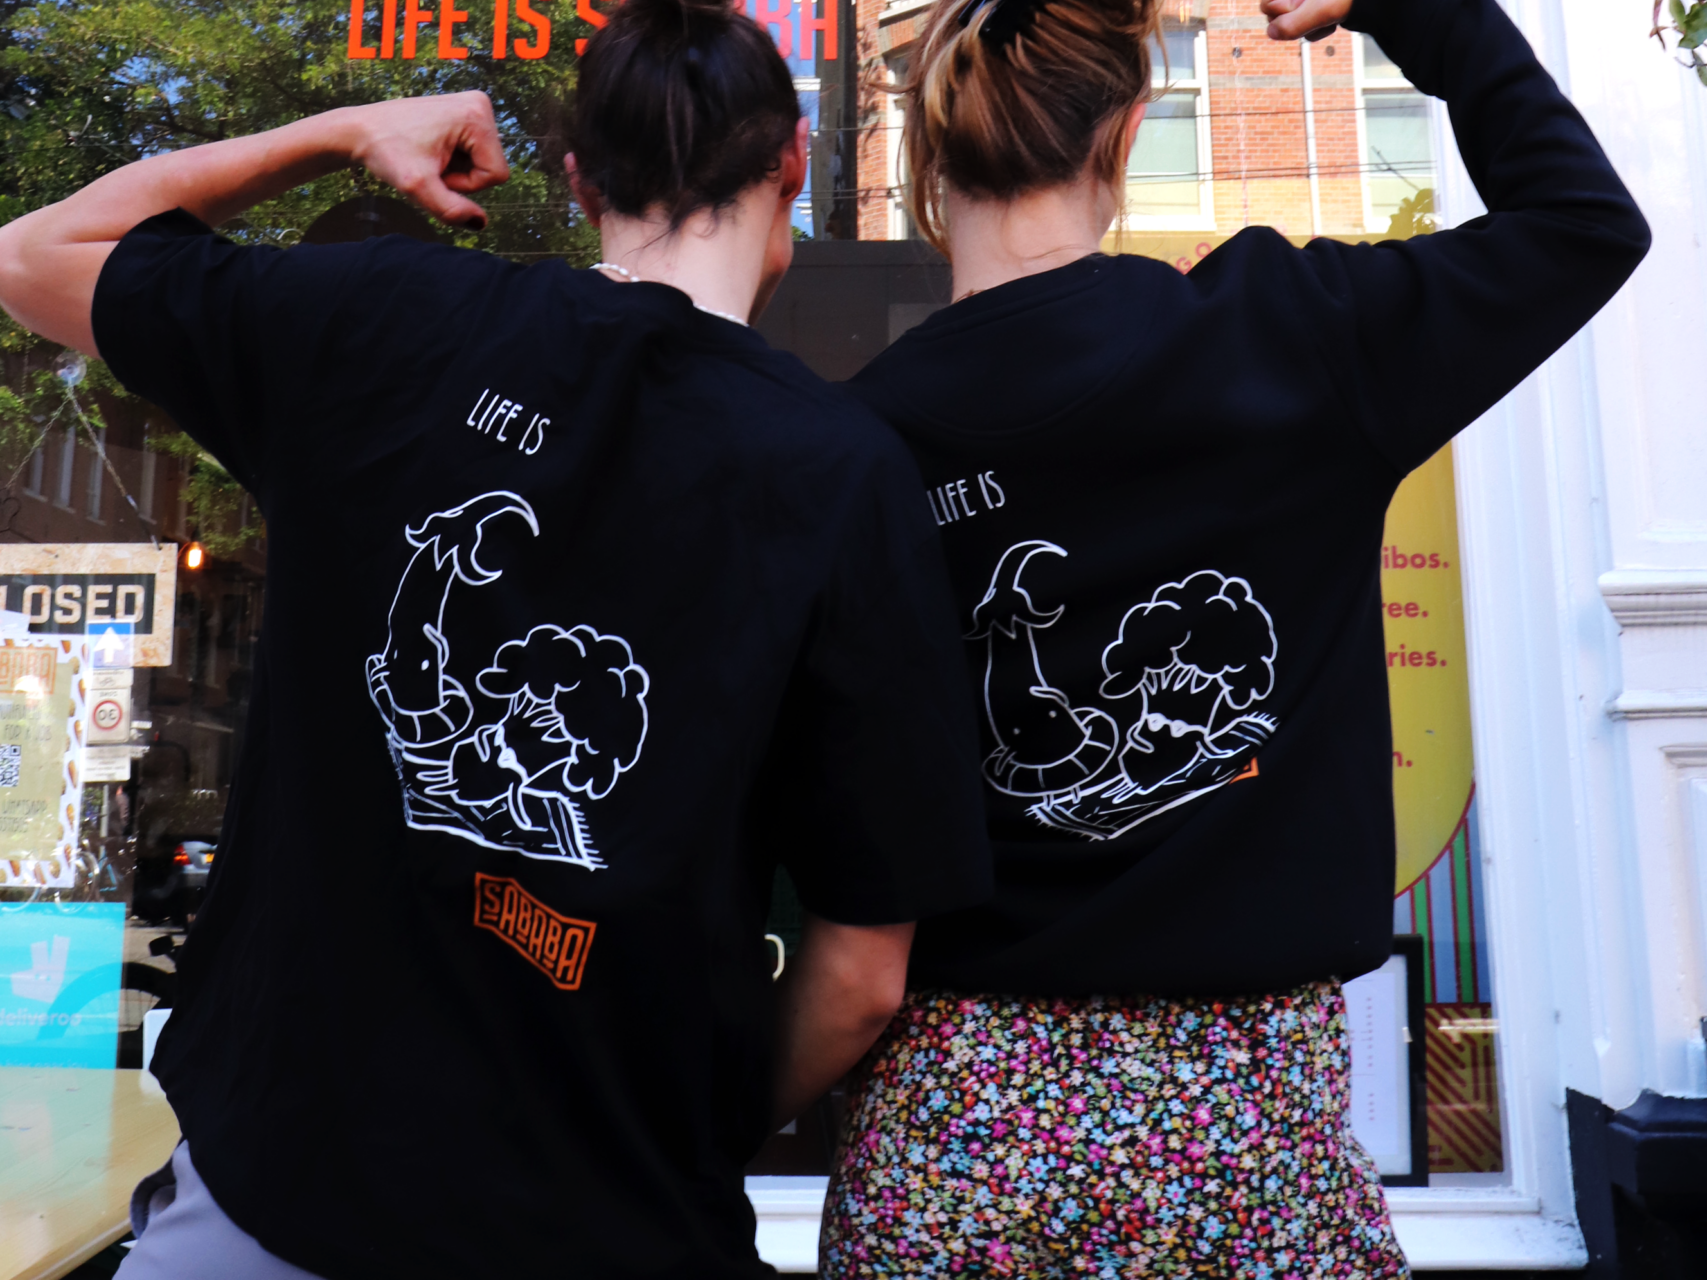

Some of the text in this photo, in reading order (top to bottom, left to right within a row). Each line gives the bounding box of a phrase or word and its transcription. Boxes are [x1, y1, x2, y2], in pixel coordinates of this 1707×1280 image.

[466, 388, 551, 455] LIFE IS
[926, 470, 1006, 526] LIFE IS
[482, 882, 585, 982] SABABA
